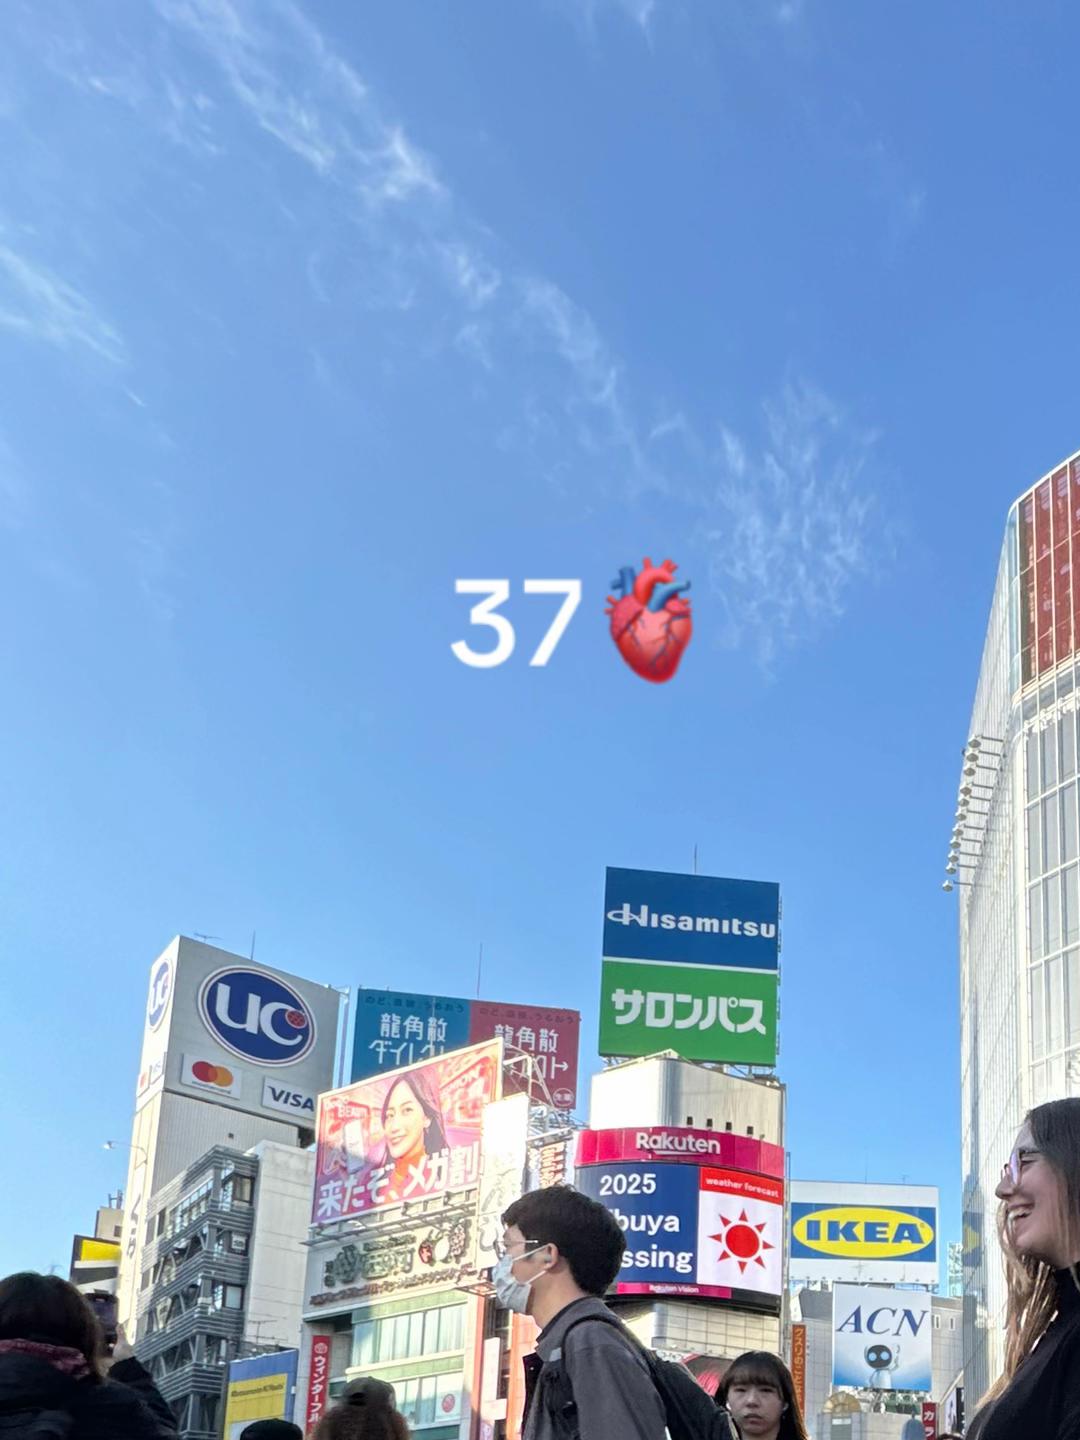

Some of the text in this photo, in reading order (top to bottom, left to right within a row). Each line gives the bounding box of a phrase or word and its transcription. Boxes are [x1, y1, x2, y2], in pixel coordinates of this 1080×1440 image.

[607, 903, 776, 938] Hisamitsu
[214, 981, 305, 1047] UC
[611, 988, 767, 1036] サロンパス
[380, 1012, 448, 1042] 龍角散
[268, 1085, 314, 1113] VISA
[635, 1131, 721, 1155] Rakuten
[317, 1142, 480, 1217] 来たぞ、メガ割
[600, 1173, 657, 1196] 2025
[706, 1177, 779, 1199] weather forecast
[611, 1209, 680, 1235] buya
[806, 1219, 925, 1245] IKEA
[836, 1304, 930, 1337] ACN
